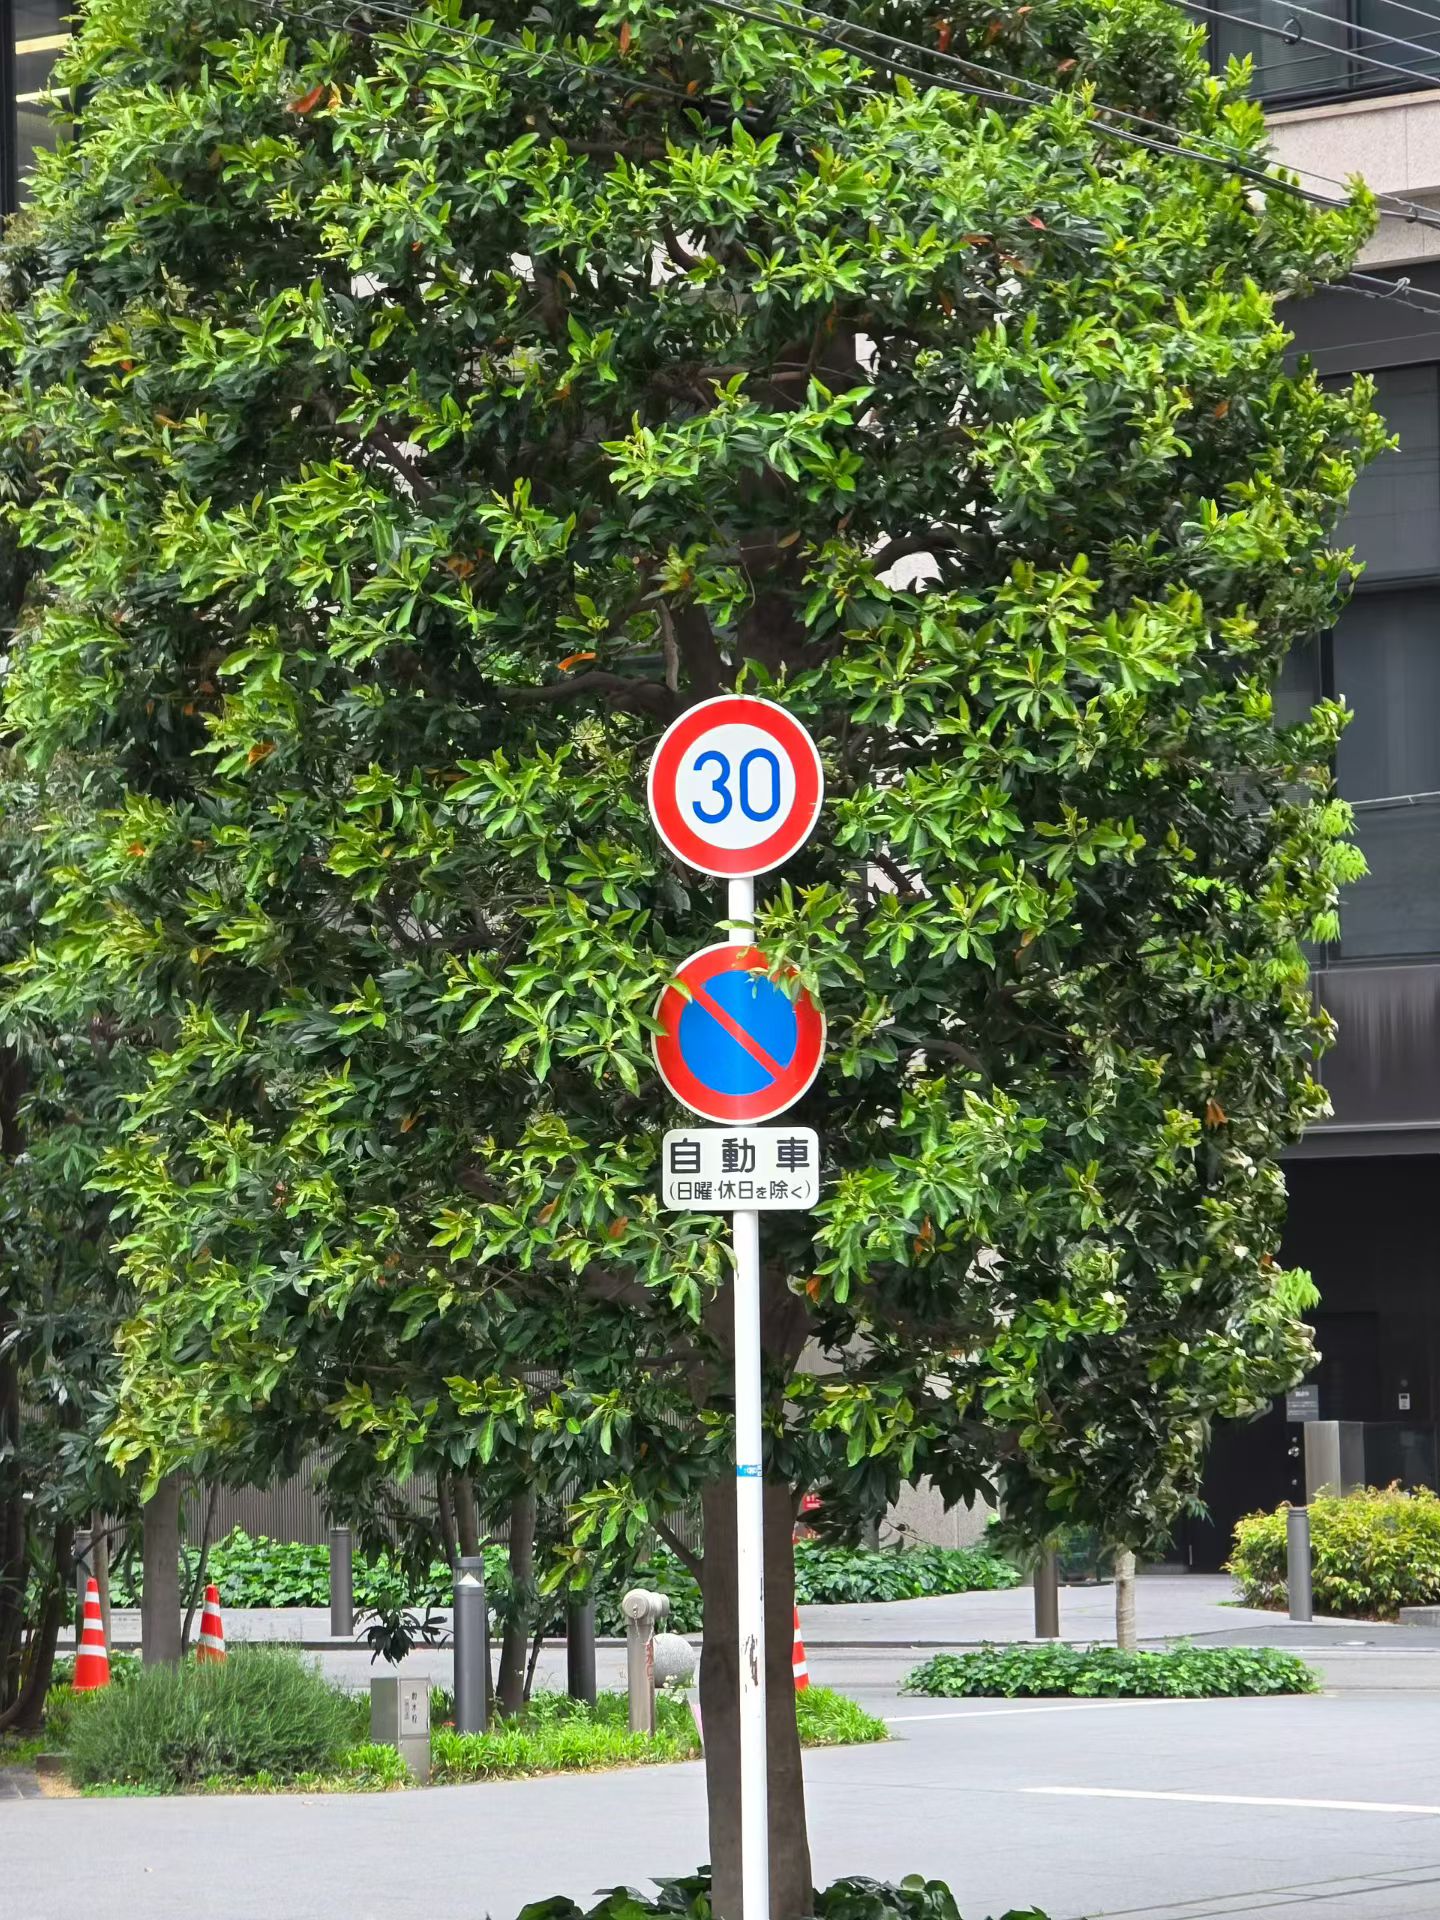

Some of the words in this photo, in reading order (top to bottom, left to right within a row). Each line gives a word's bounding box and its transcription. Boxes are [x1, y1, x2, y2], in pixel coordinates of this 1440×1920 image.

[692, 747, 781, 825] 30
[670, 1136, 810, 1174] 自動車
